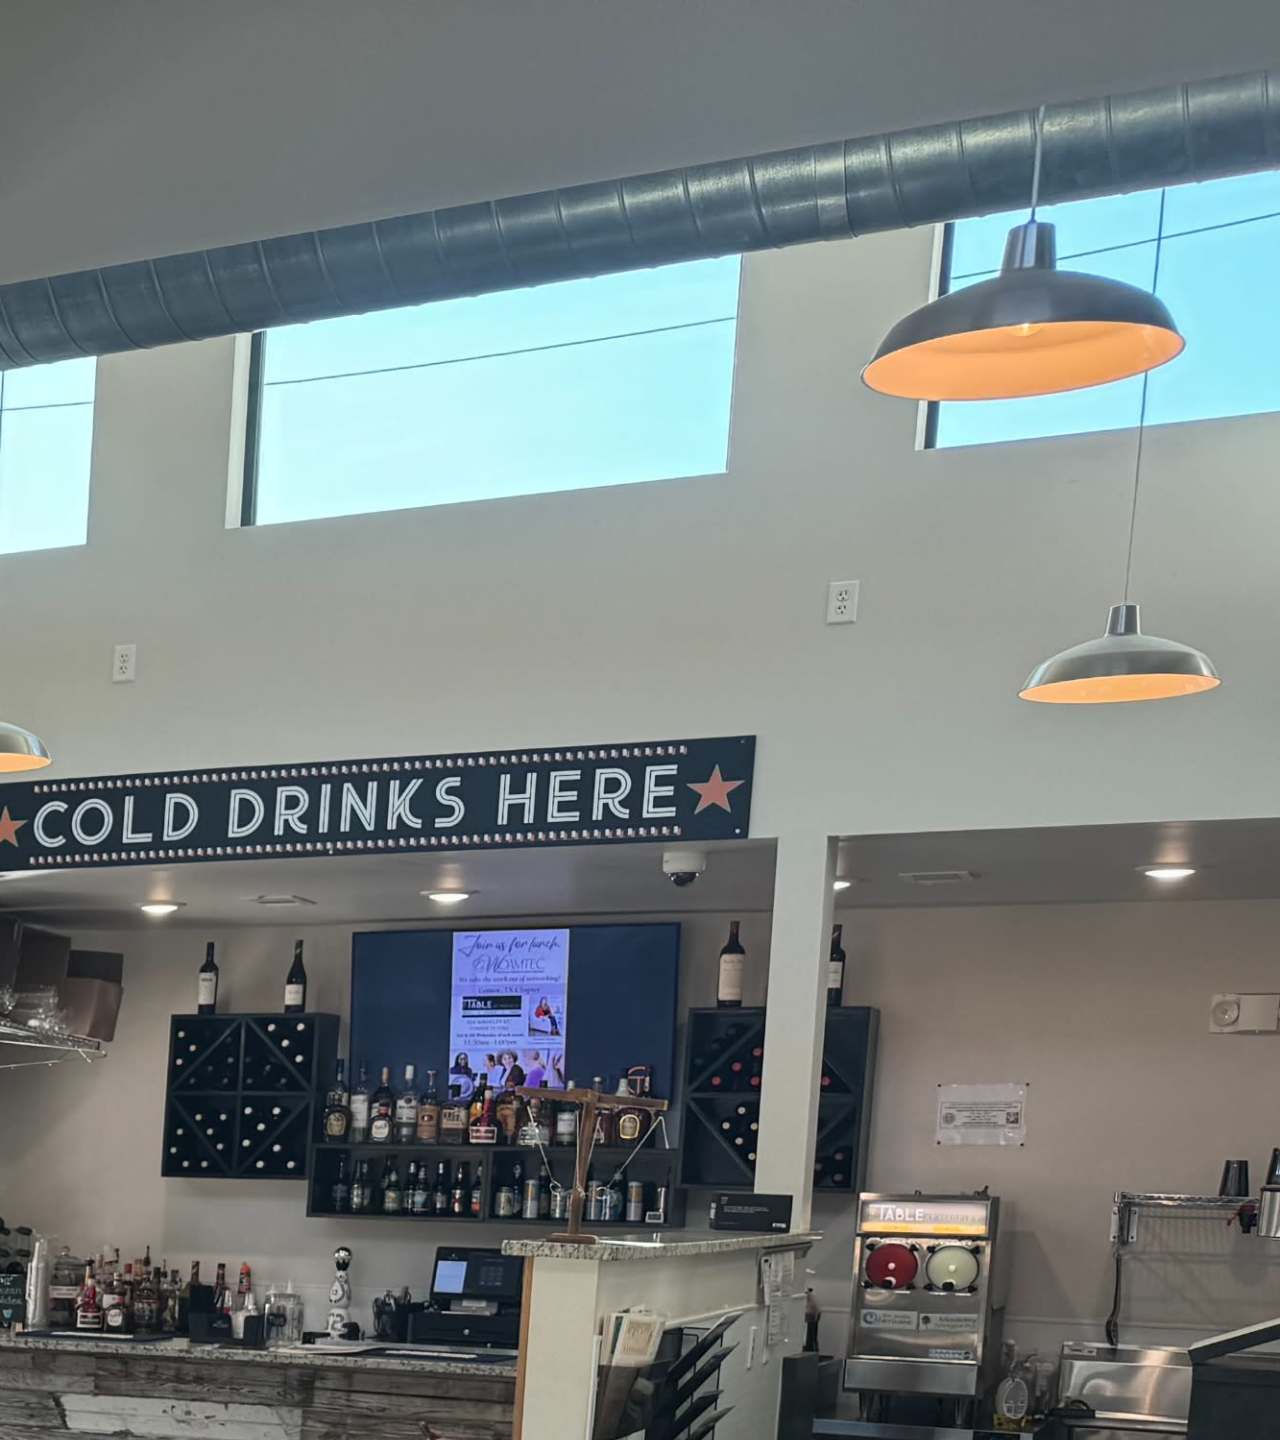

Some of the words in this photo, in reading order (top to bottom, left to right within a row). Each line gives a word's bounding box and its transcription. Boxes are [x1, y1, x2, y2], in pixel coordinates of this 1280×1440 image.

[33, 792, 199, 849] COLD
[227, 776, 463, 839] DRINKS
[496, 764, 679, 826] HERE
[458, 934, 493, 957] Join
[495, 942, 505, 952] us
[508, 937, 528, 953] for
[878, 1204, 925, 1221] TABLE
